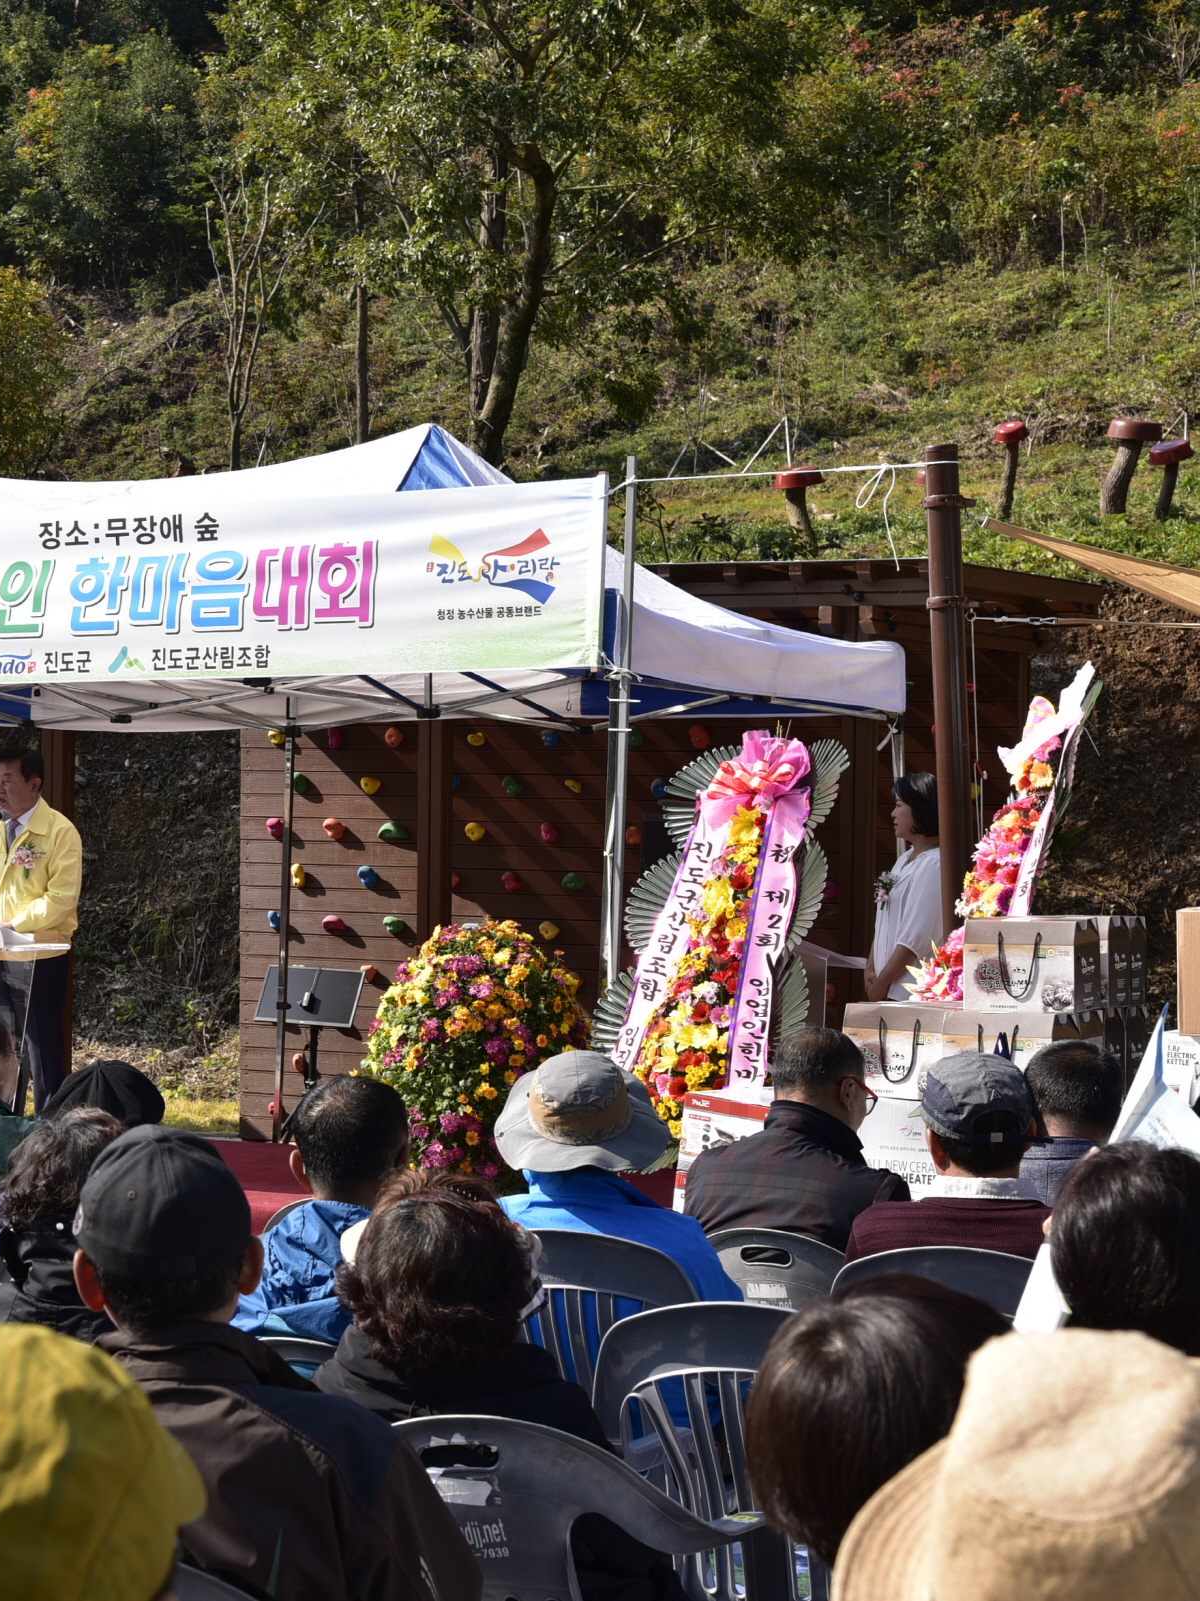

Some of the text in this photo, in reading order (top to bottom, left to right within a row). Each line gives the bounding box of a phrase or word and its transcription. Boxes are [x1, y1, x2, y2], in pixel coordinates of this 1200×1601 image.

[38, 511, 220, 551] 장소:무장애 숲
[69, 538, 380, 637] 한마음대회
[437, 605, 542, 621] 청정 농수산물 공동브랜드
[43, 650, 92, 674] 진도군
[151, 643, 272, 671] 진도군산림조합
[638, 840, 713, 1002] 진도군산림조합
[755, 888, 790, 951] 제2회
[1166, 1051, 1197, 1060] ELECTRIC
[1166, 1059, 1190, 1067] KETTLE
[885, 1159, 909, 1173] NEW
[460, 1518, 508, 1549] djj.net
